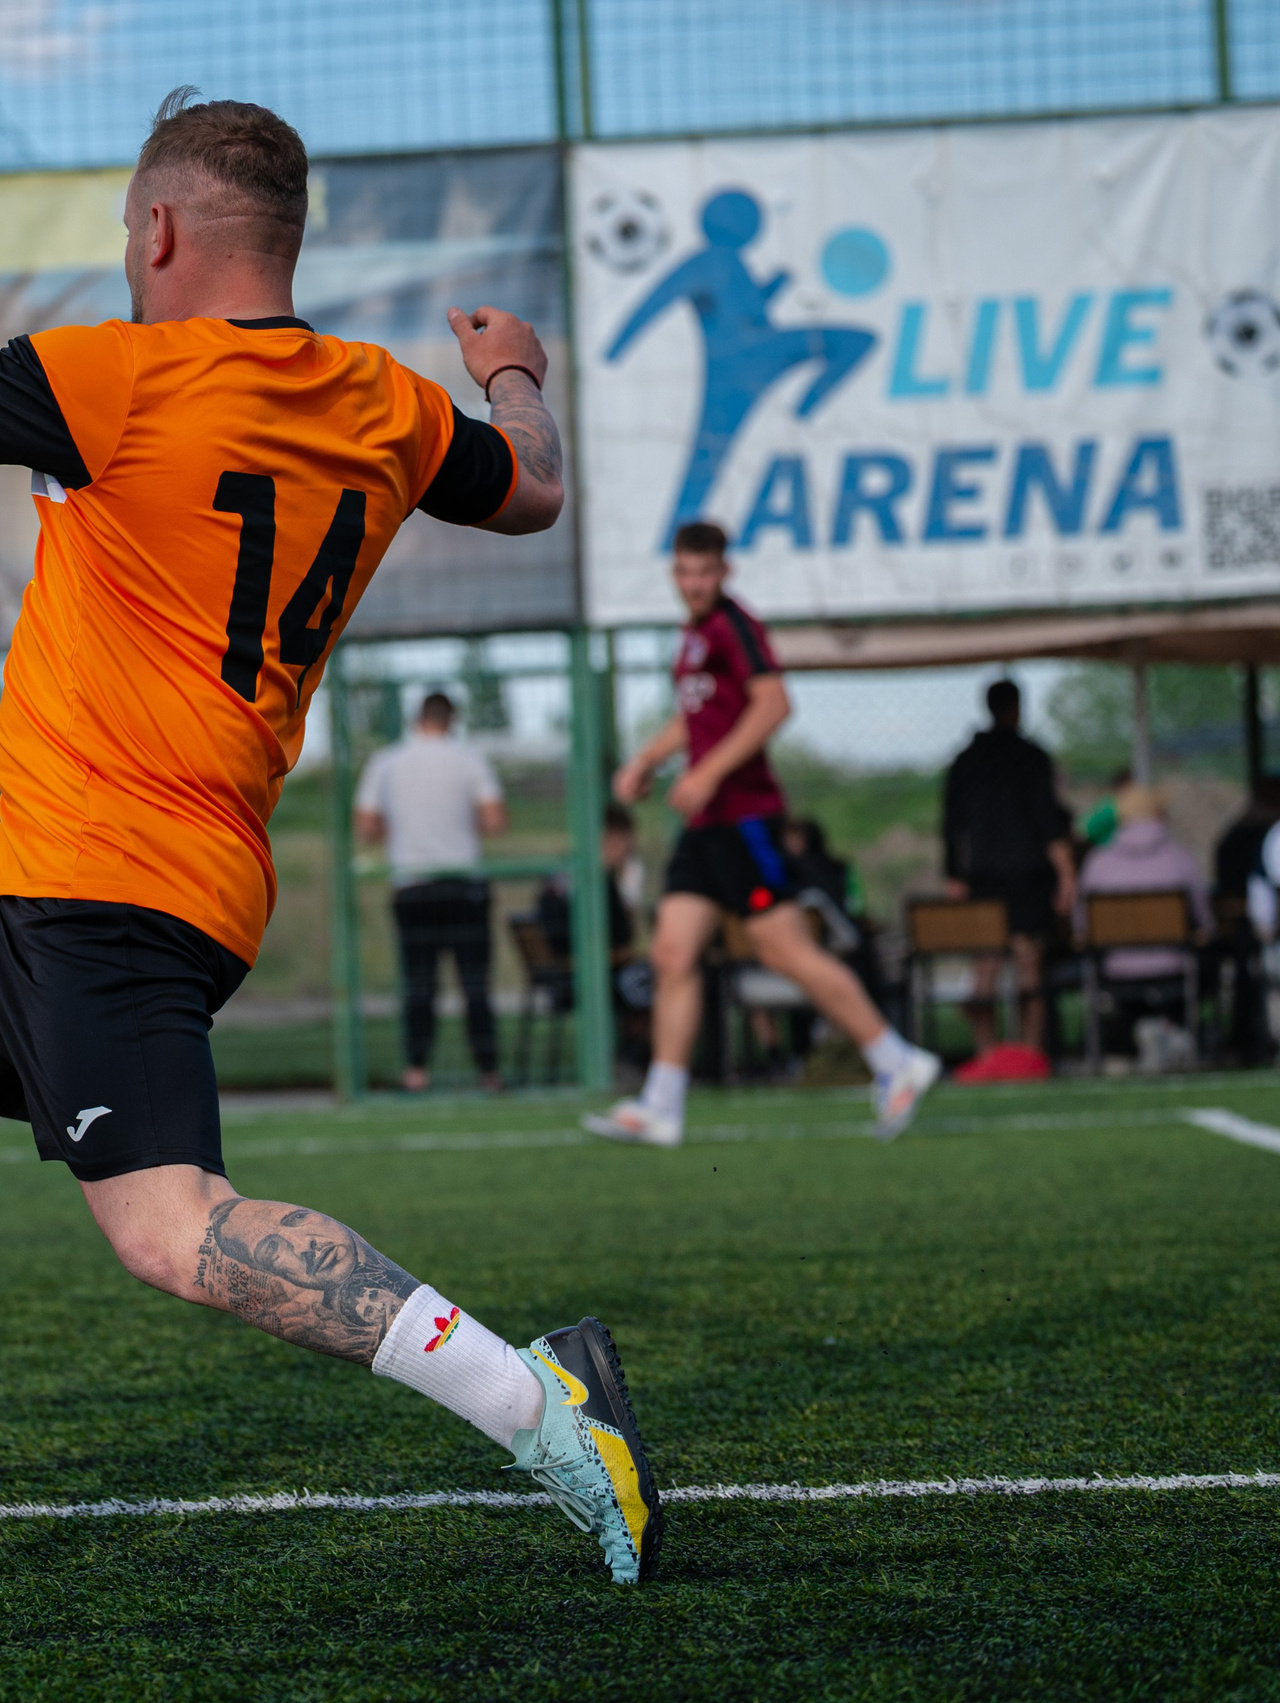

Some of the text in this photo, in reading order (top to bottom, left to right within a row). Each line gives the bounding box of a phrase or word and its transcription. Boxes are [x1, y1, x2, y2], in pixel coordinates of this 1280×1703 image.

[888, 287, 1173, 397] LIVE
[733, 432, 1183, 551] ARENA
[213, 470, 367, 711] 14
